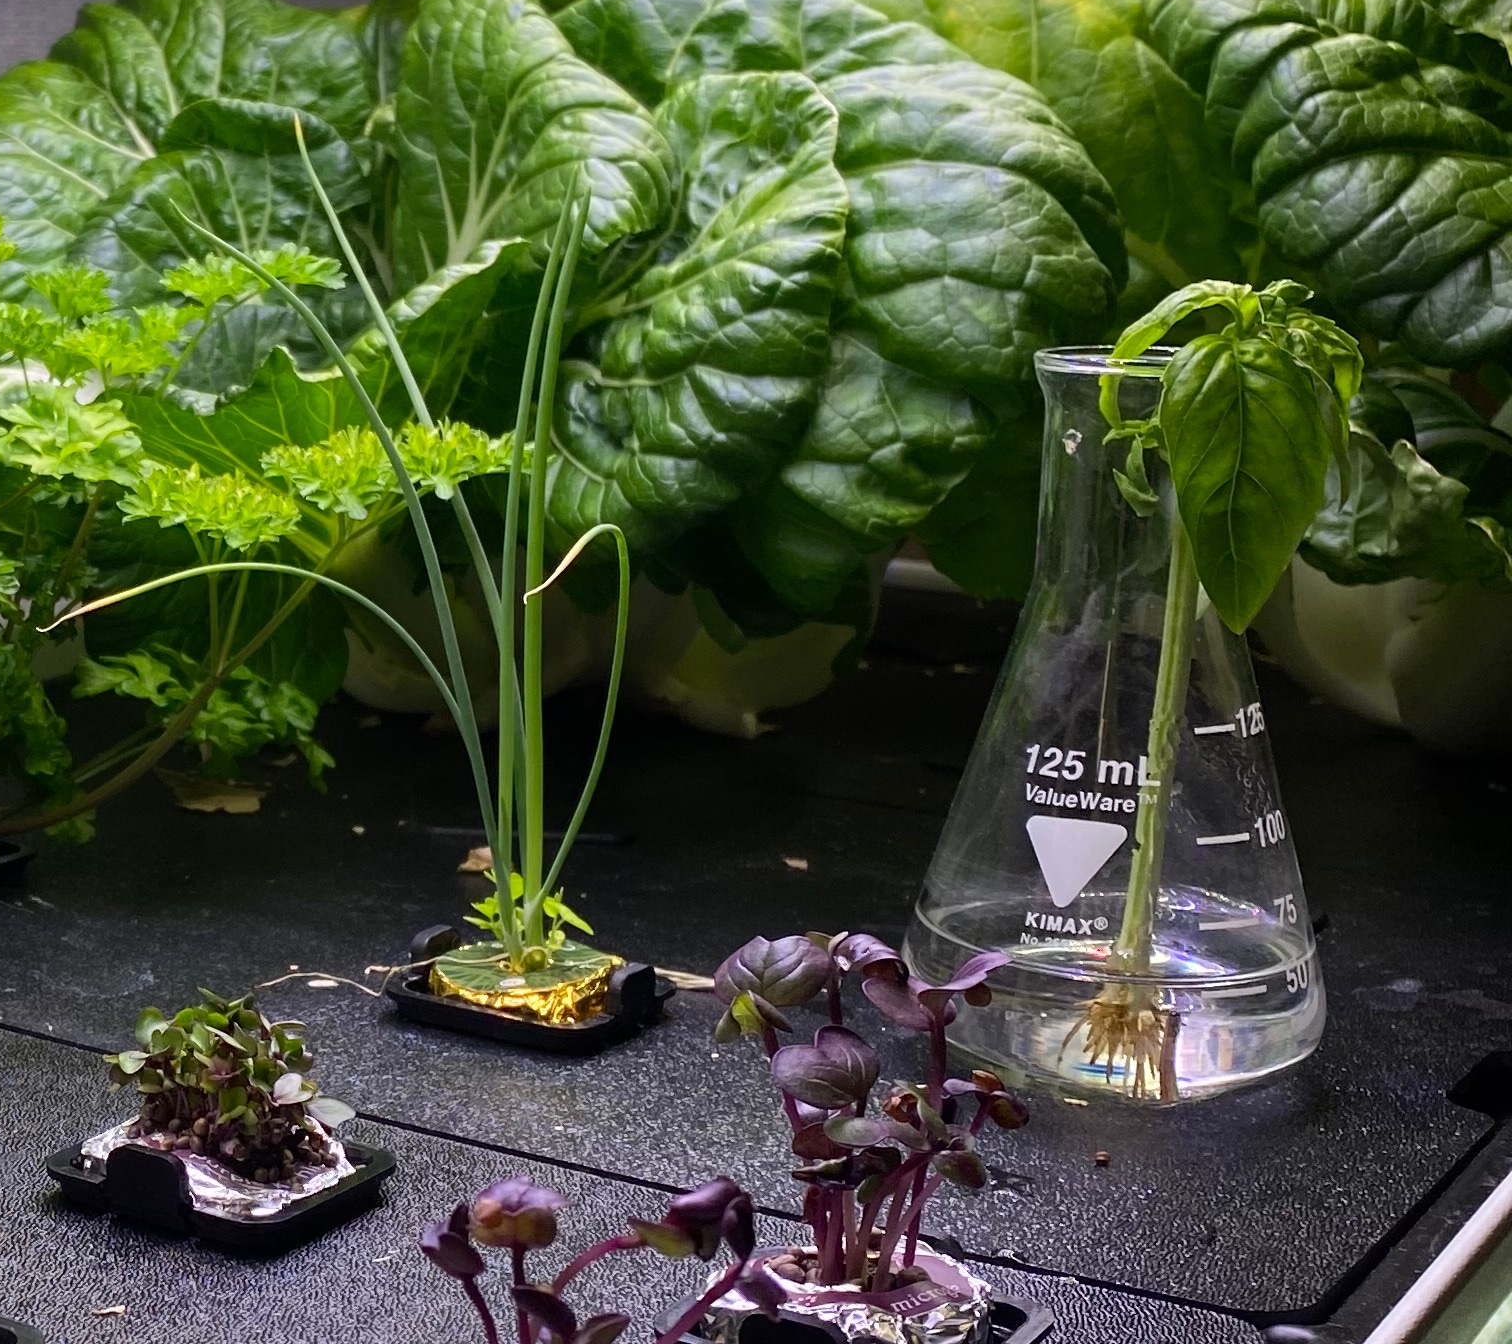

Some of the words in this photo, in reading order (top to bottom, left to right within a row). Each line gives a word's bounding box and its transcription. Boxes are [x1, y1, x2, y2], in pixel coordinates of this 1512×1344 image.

[1026, 744, 1086, 781] 125
[1097, 755, 1161, 787] mL
[1254, 810, 1286, 847] 100
[1273, 894, 1297, 926] 75
[1287, 961, 1309, 993] 50
